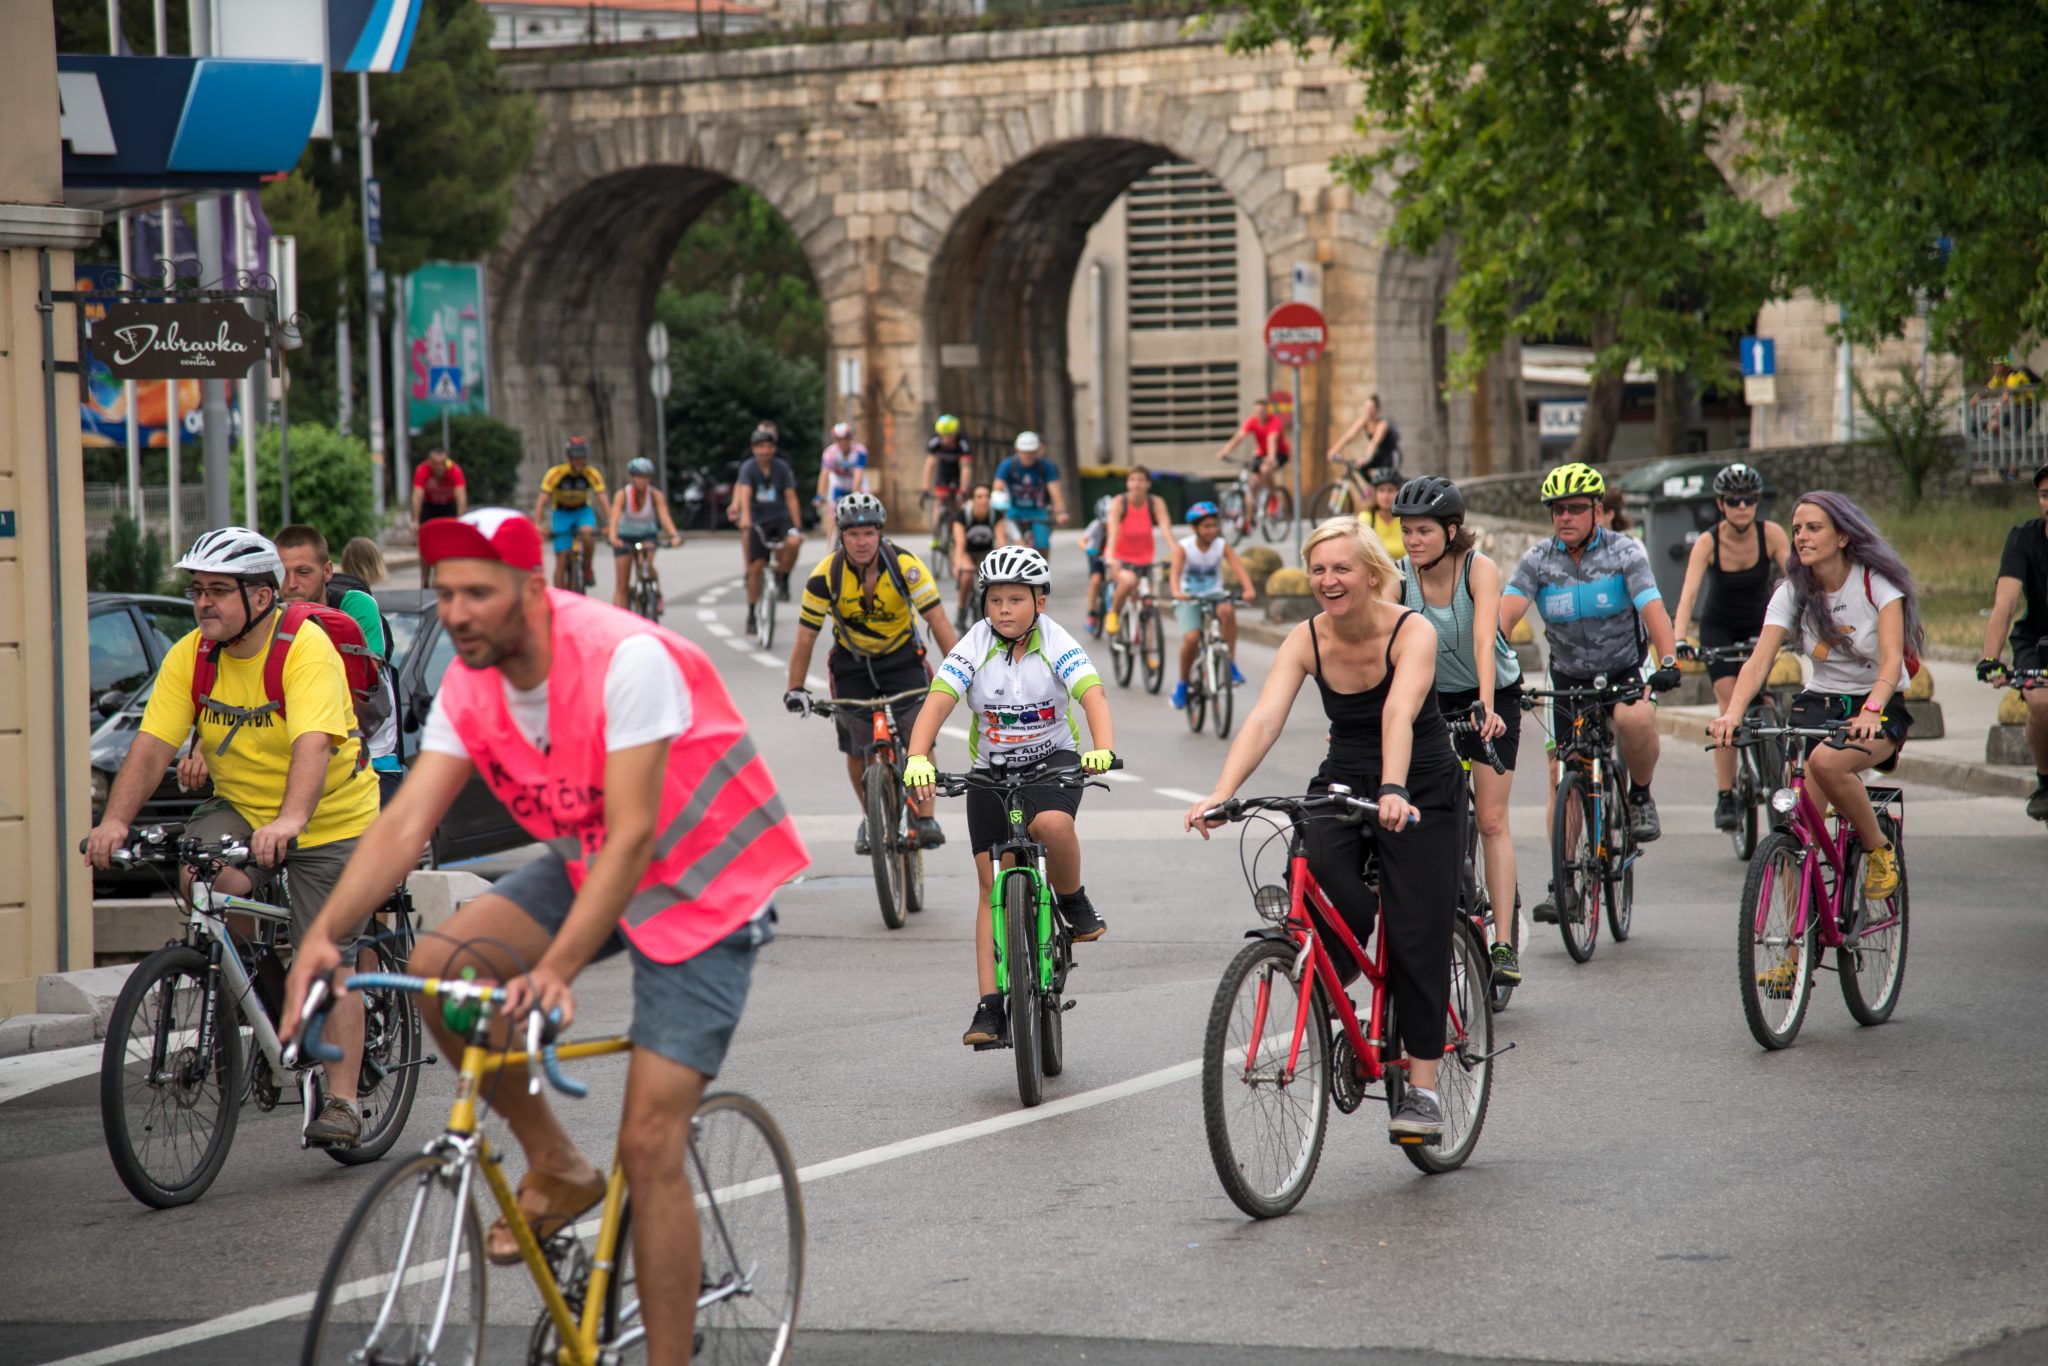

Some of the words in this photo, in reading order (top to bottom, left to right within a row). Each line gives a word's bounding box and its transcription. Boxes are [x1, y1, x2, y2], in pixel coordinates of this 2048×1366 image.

[113, 320, 248, 365] Dubravka
[984, 699, 1054, 711] SPORT
[1007, 743, 1058, 762] ROBNIK
[1022, 739, 1052, 754] AUTO
